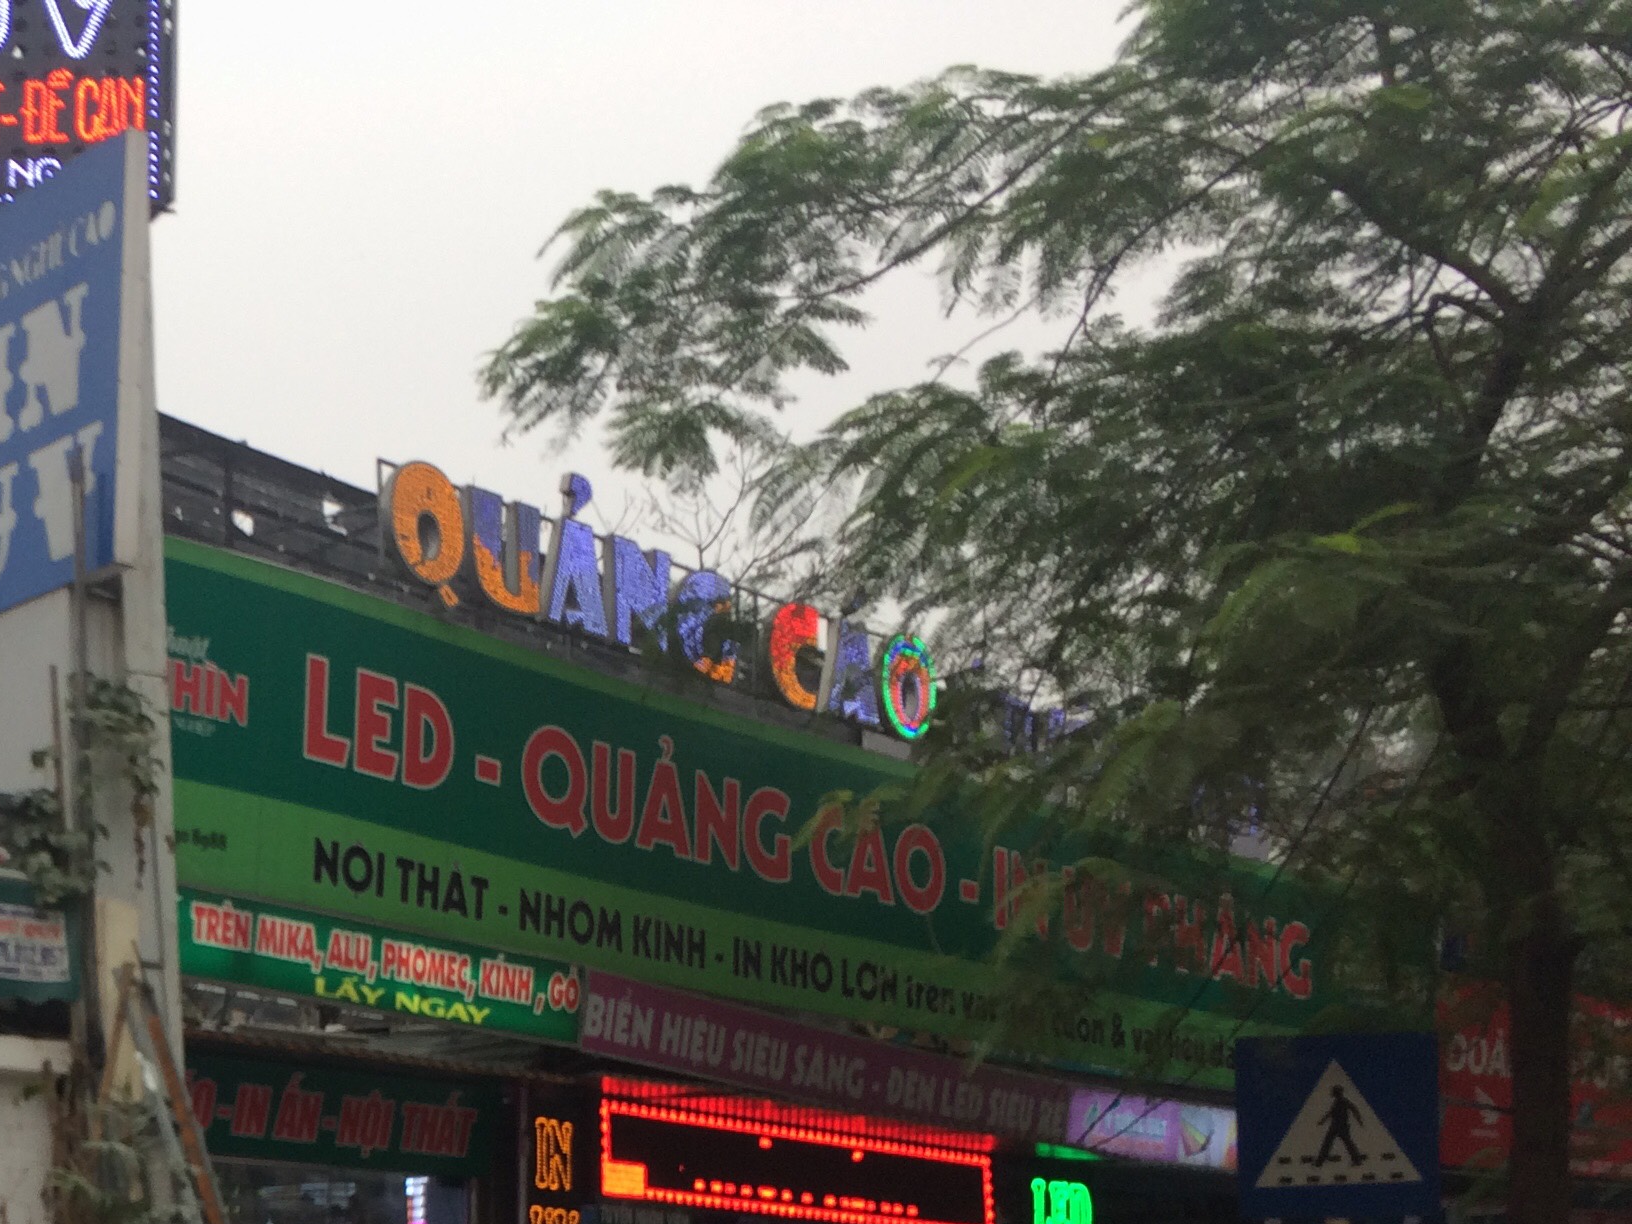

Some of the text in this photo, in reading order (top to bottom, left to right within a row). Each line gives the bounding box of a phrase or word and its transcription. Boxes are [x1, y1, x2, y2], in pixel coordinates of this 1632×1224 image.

[390, 460, 742, 686] QUẢNG
[303, 652, 455, 791] LED
[521, 735, 792, 884] QUẢNG
[191, 899, 253, 953] TRÊN
[732, 935, 763, 981] IN
[314, 975, 491, 1026] LẤY NGAY
[534, 1115, 574, 1193] IN
